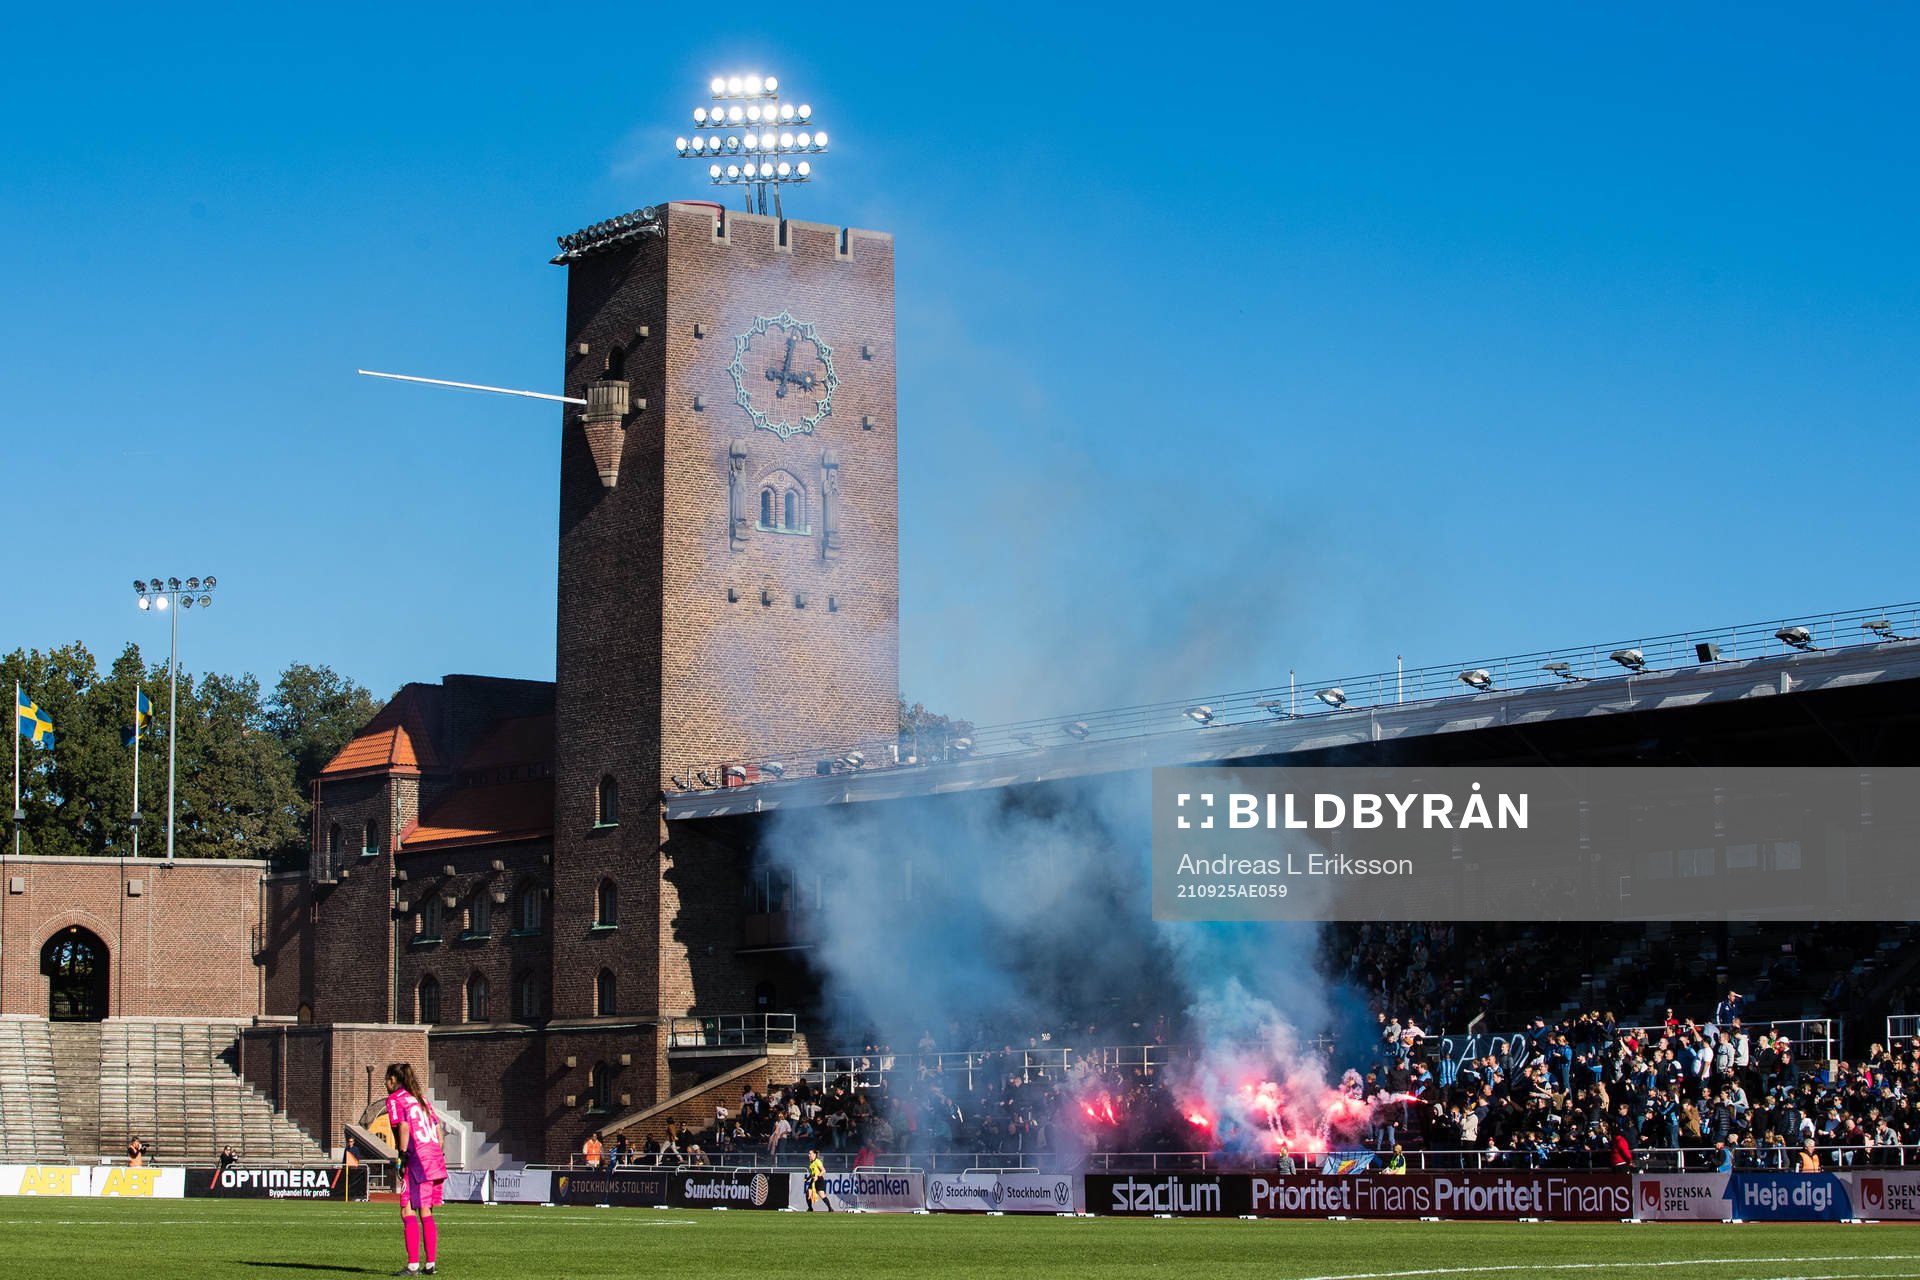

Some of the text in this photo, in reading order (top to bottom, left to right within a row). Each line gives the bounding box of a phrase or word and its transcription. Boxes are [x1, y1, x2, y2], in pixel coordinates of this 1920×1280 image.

[18, 1167, 80, 1195] ABT
[102, 1168, 162, 1196] ABT
[221, 1170, 330, 1188] OPTIMERA
[571, 1181, 660, 1194] STOCKHOLMS STOLTHET
[804, 1173, 910, 1195] ndelsbanken
[269, 1189, 330, 1198] Bygghandel för proffs
[684, 1178, 750, 1199] Sundström
[946, 1186, 989, 1198] Stockholm
[1007, 1186, 1051, 1199] Stockholm
[1112, 1176, 1220, 1211] stadium
[1251, 1178, 1630, 1212] Prioritet Finans Prioritet Finans
[1664, 1187, 1712, 1198] SVENSKA
[1744, 1181, 1832, 1212] Heja dig!
[1664, 1200, 1689, 1211] SPEL
[1888, 1198, 1915, 1210] SPEL
